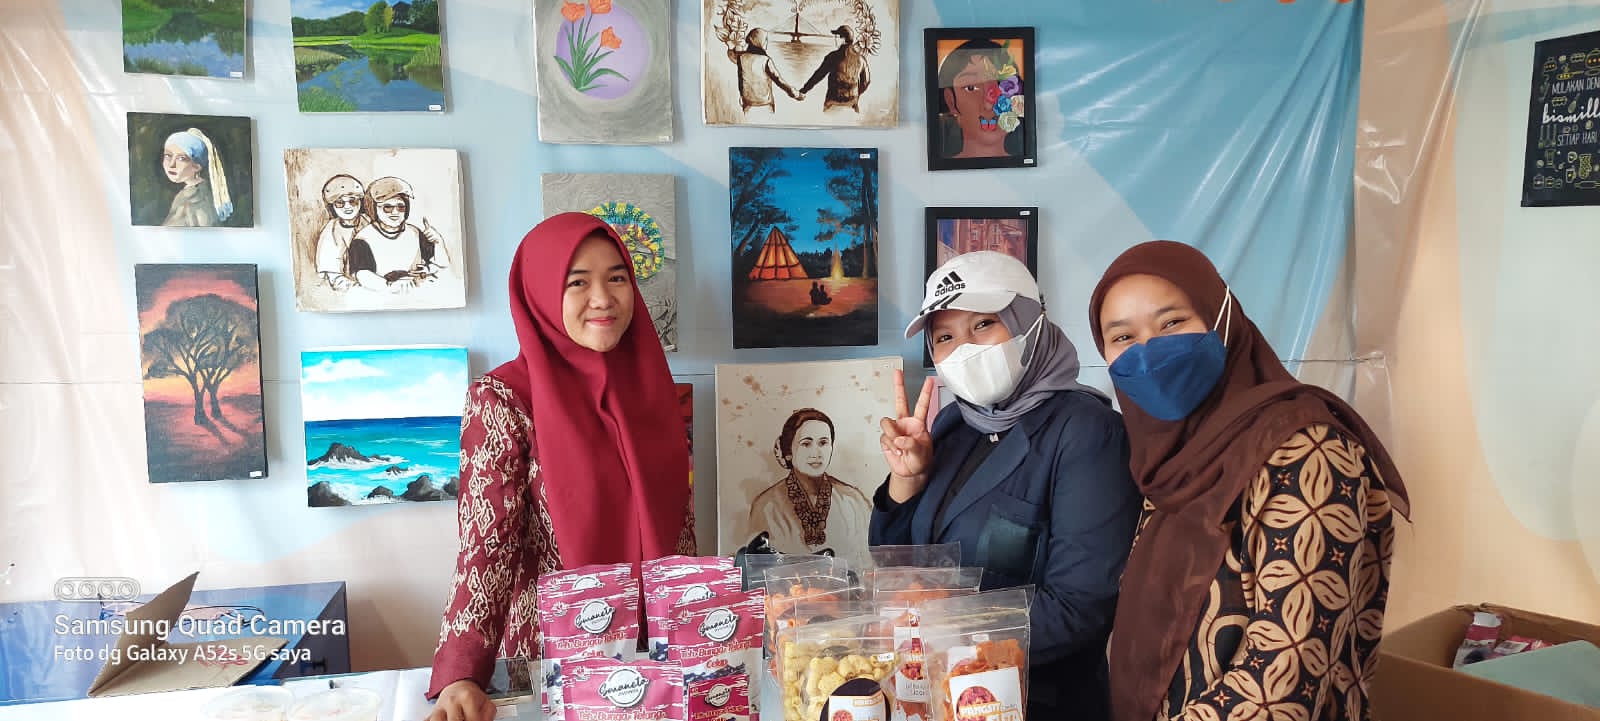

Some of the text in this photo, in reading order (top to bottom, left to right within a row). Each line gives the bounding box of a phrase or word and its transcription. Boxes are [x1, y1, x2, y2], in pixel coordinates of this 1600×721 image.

[1557, 131, 1598, 147] SETIAP HARI
[934, 282, 966, 296] adidas
